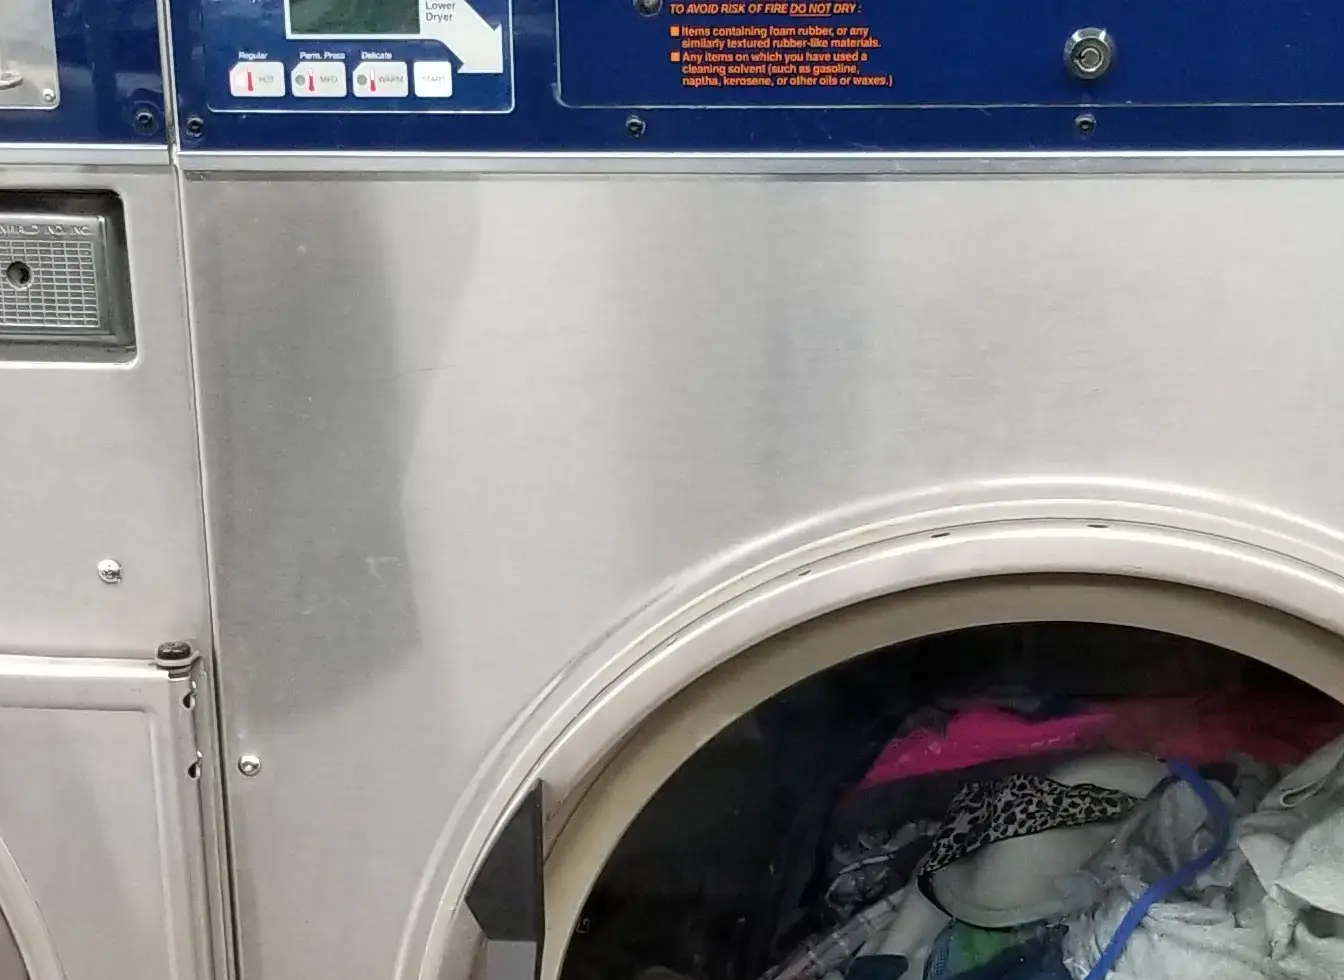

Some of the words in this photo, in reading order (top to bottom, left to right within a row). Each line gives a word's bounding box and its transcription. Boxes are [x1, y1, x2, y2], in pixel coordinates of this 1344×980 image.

[425, 0, 456, 10] Lower
[670, 3, 685, 14] TO
[686, 3, 719, 14] AVOID
[721, 3, 746, 14] RISK
[748, 3, 764, 14] OF
[765, 3, 789, 14] FIRE
[790, 3, 807, 14] DO
[808, 3, 832, 14] NOT
[425, 12, 453, 23] Dryer
[682, 26, 711, 37] Items
[712, 26, 768, 38] containing
[769, 26, 796, 36] foam
[797, 26, 835, 37] rubber,
[836, 27, 848, 36] or
[849, 27, 869, 38] any
[681, 38, 725, 50] similarly
[726, 38, 770, 49] textured
[772, 38, 828, 48] rubber-like
[830, 37, 882, 48] materials.
[238, 51, 269, 60] Regular
[360, 51, 393, 60] Delicate
[682, 51, 703, 64] Any
[704, 52, 734, 61] items
[735, 53, 749, 61] on
[751, 52, 783, 61] which
[784, 53, 804, 64] you
[805, 52, 831, 61] have
[832, 51, 859, 61] used
[860, 53, 868, 61] a
[682, 64, 726, 76] cleaning
[727, 64, 766, 74] solvent
[767, 63, 797, 76] (such
[798, 64, 812, 74] as
[813, 64, 860, 76] gasoline,
[378, 75, 404, 84] WARM
[723, 75, 775, 87] kerosene,
[776, 76, 788, 86] or
[789, 76, 817, 86] other
[819, 75, 838, 86] oils
[839, 76, 851, 86] or
[852, 75, 893, 87] waxes.)
